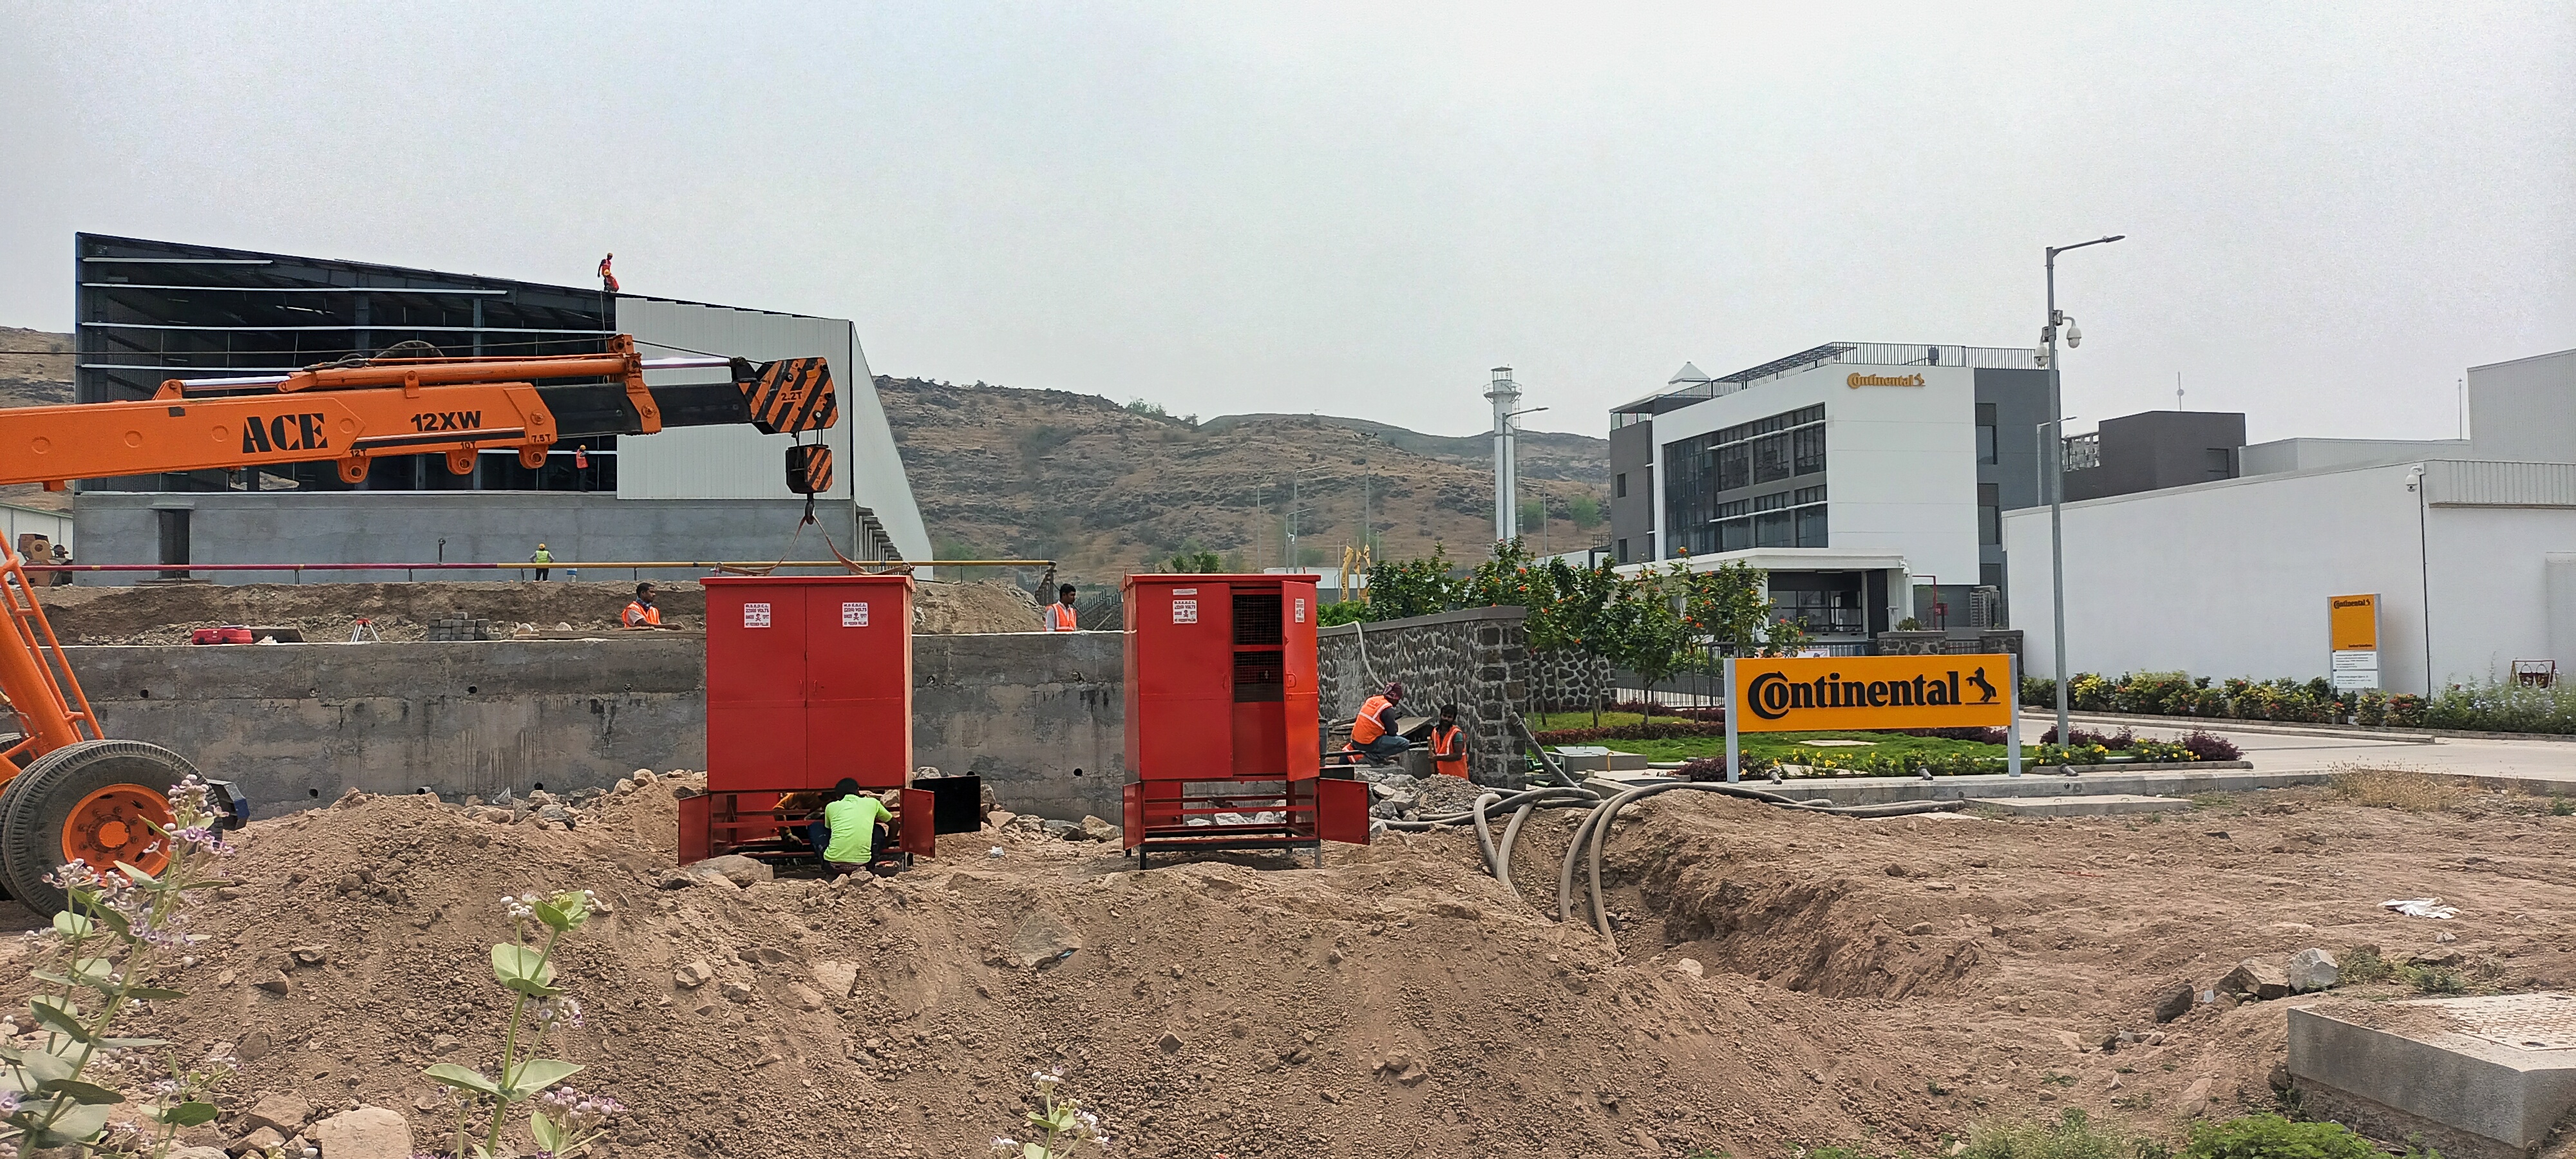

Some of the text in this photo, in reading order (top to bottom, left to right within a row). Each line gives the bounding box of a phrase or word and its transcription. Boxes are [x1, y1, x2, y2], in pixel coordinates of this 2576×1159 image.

[1847, 372, 1913, 390] Continental
[781, 391, 802, 401] 2.2T
[410, 411, 481, 431] 12XW
[243, 413, 328, 453] ACE
[531, 434, 551, 442] 7.5T
[460, 441, 476, 449] 10T
[350, 449, 366, 457] 12T
[2334, 599, 2365, 609] Continental
[1748, 671, 1962, 719] Continental
